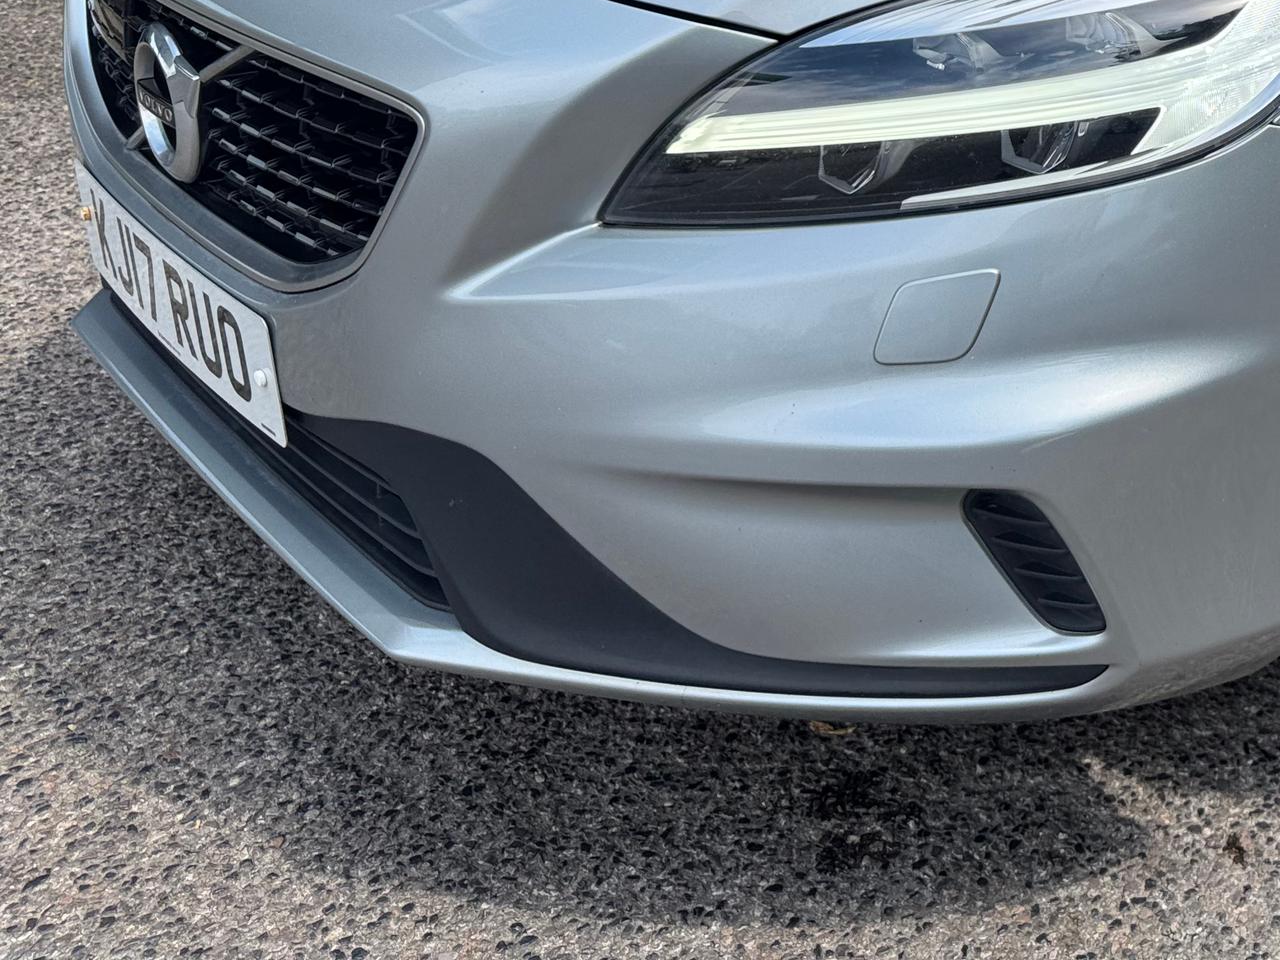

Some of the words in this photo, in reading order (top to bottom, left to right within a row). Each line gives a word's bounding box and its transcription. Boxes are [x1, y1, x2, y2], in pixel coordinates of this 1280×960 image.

[139, 90, 173, 121] VOLVO
[91, 188, 157, 322] KJ17
[162, 259, 252, 402] RUO
